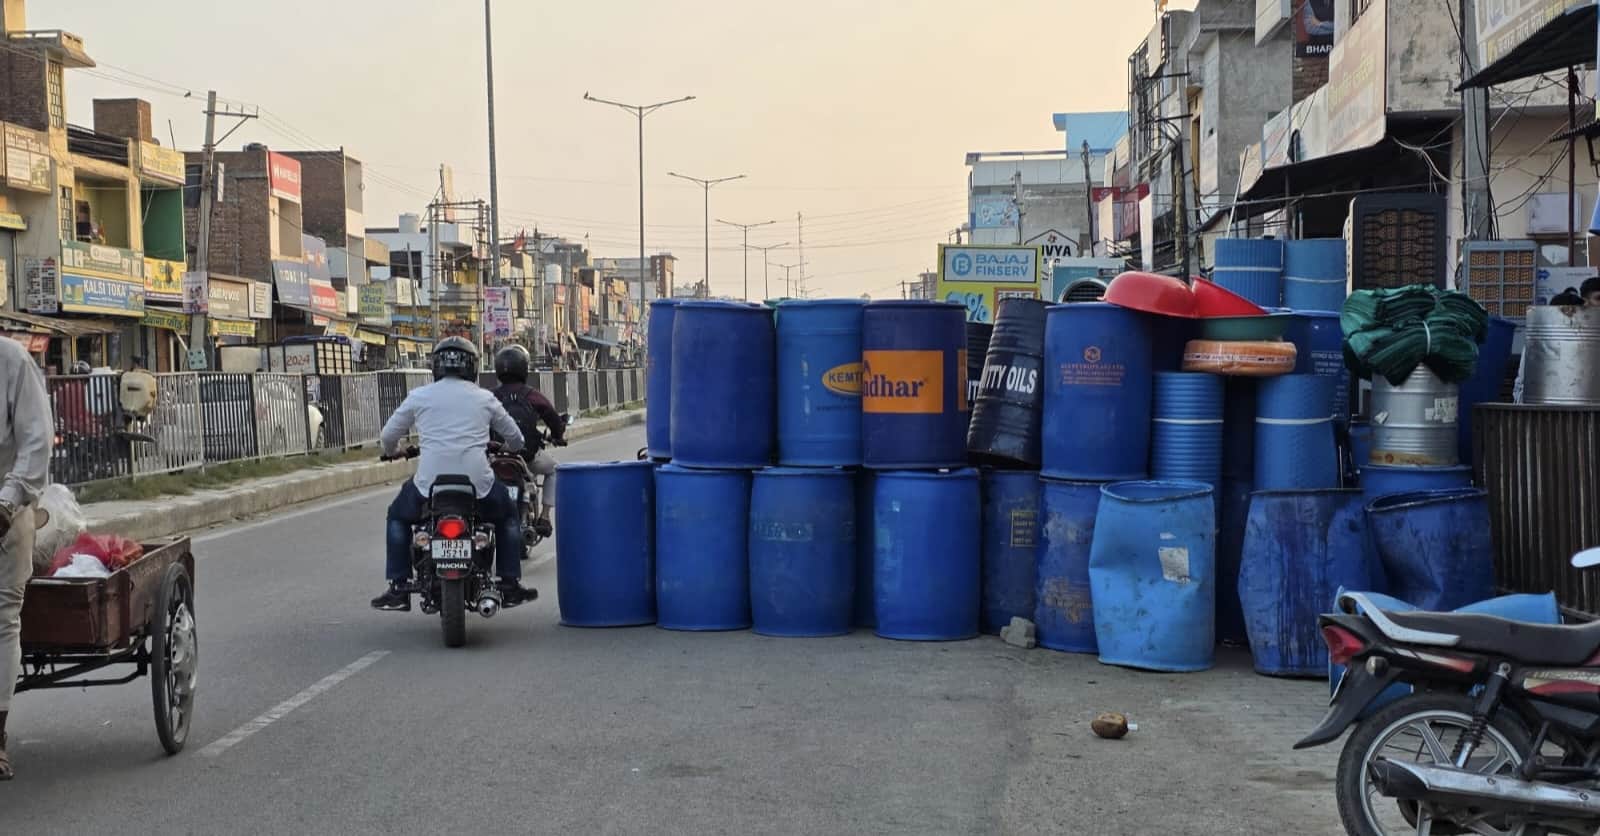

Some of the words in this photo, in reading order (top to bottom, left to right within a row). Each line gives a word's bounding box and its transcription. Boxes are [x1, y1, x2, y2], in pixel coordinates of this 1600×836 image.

[1041, 244, 1072, 257] IVYA
[975, 253, 1029, 264] BAJAJ
[975, 265, 1029, 276] FINSERV
[83, 280, 106, 295] KALSI
[107, 282, 127, 297] TOKA
[863, 374, 923, 398] ndhar
[1006, 366, 1038, 393] OILS
